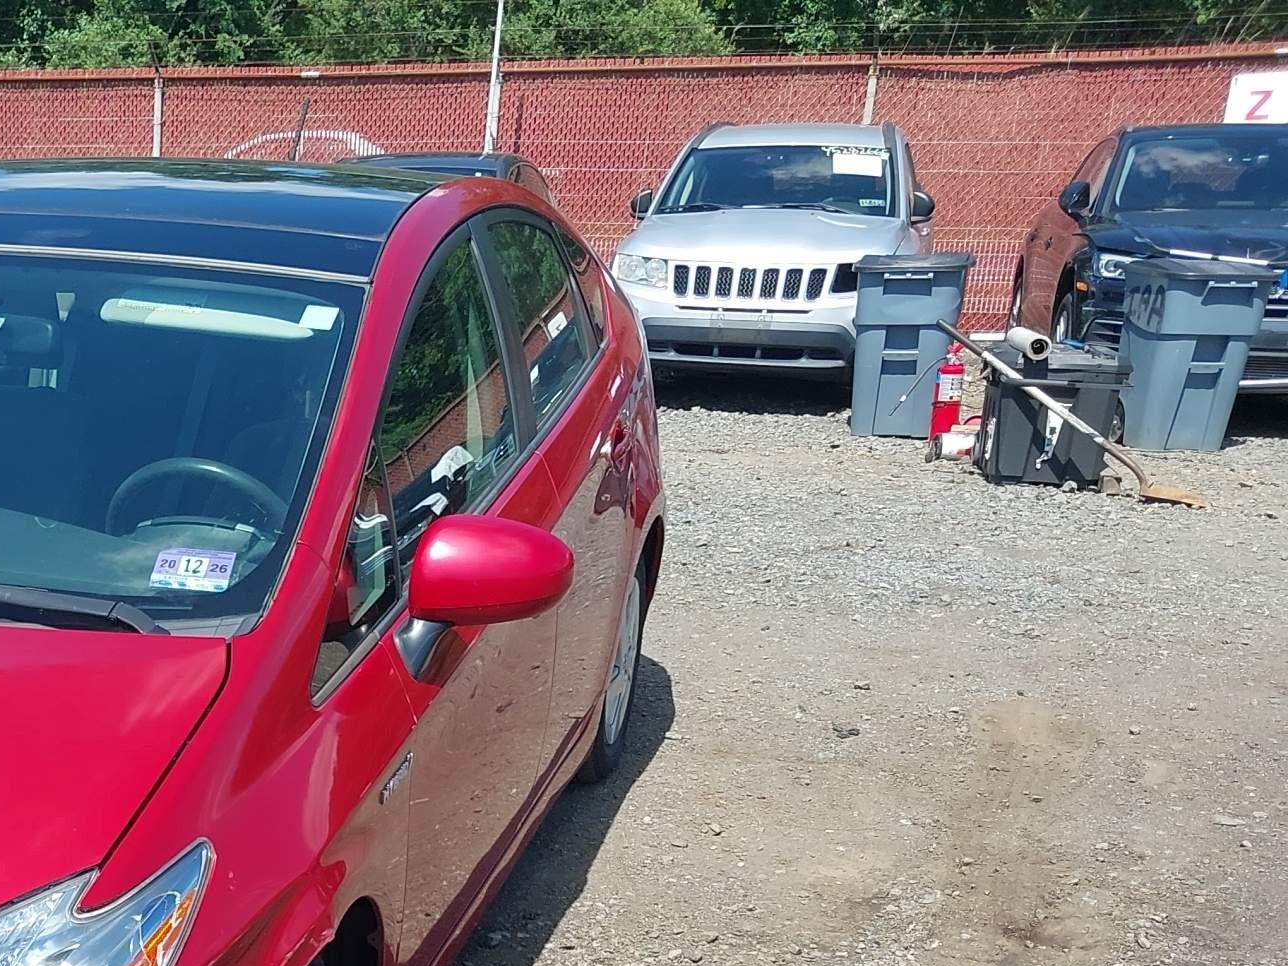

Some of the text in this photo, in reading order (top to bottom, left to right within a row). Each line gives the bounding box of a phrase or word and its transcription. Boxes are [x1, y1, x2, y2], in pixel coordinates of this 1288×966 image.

[1245, 90, 1273, 121] Z
[160, 558, 229, 574] 20 12 26
